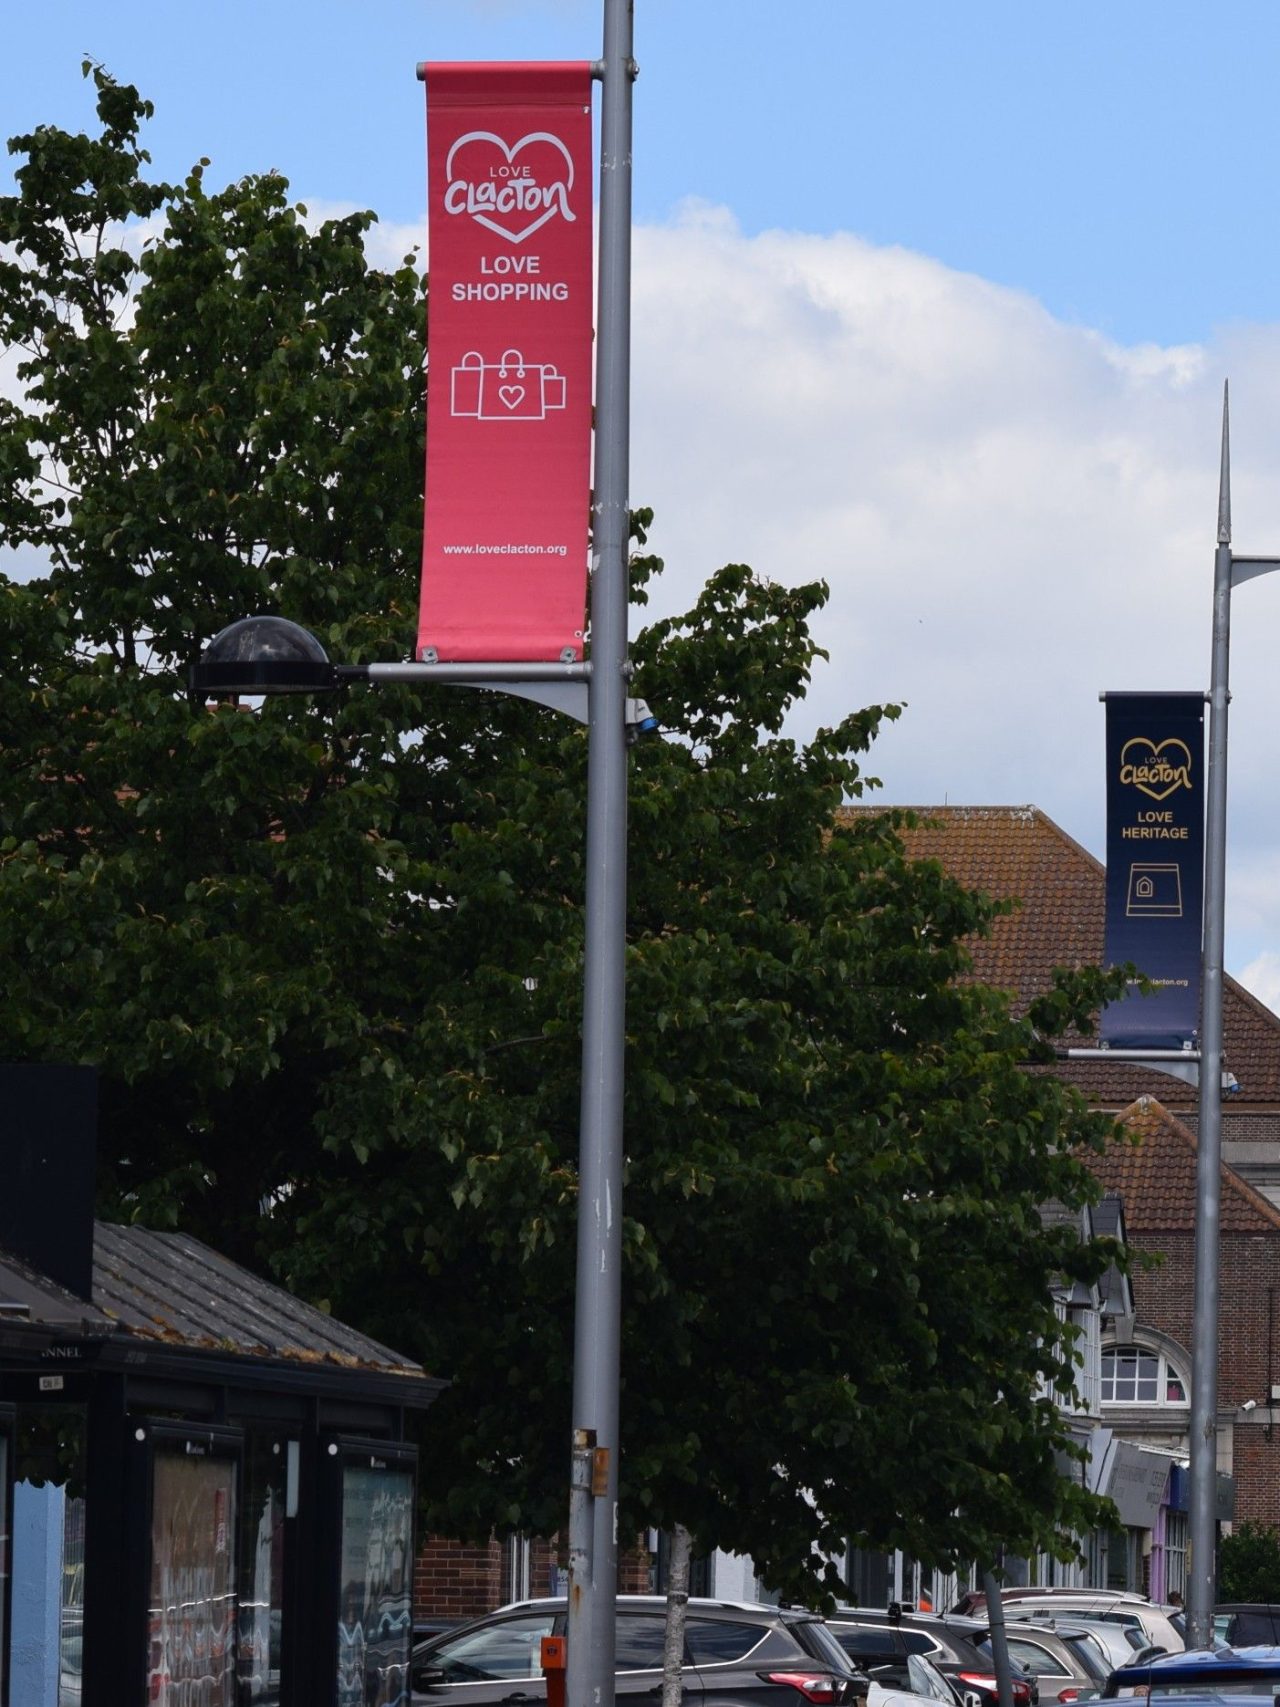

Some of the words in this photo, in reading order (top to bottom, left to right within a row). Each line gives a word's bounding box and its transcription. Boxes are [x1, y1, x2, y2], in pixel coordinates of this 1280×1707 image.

[490, 166, 531, 178] LOVE
[480, 255, 540, 274] LOVE
[451, 282, 569, 301] SHOPPING
[443, 543, 568, 557] www.loveclacton.org
[1144, 756, 1168, 765] LOVE
[1137, 811, 1173, 823] LOVE
[1122, 827, 1189, 839] HERITAGE
